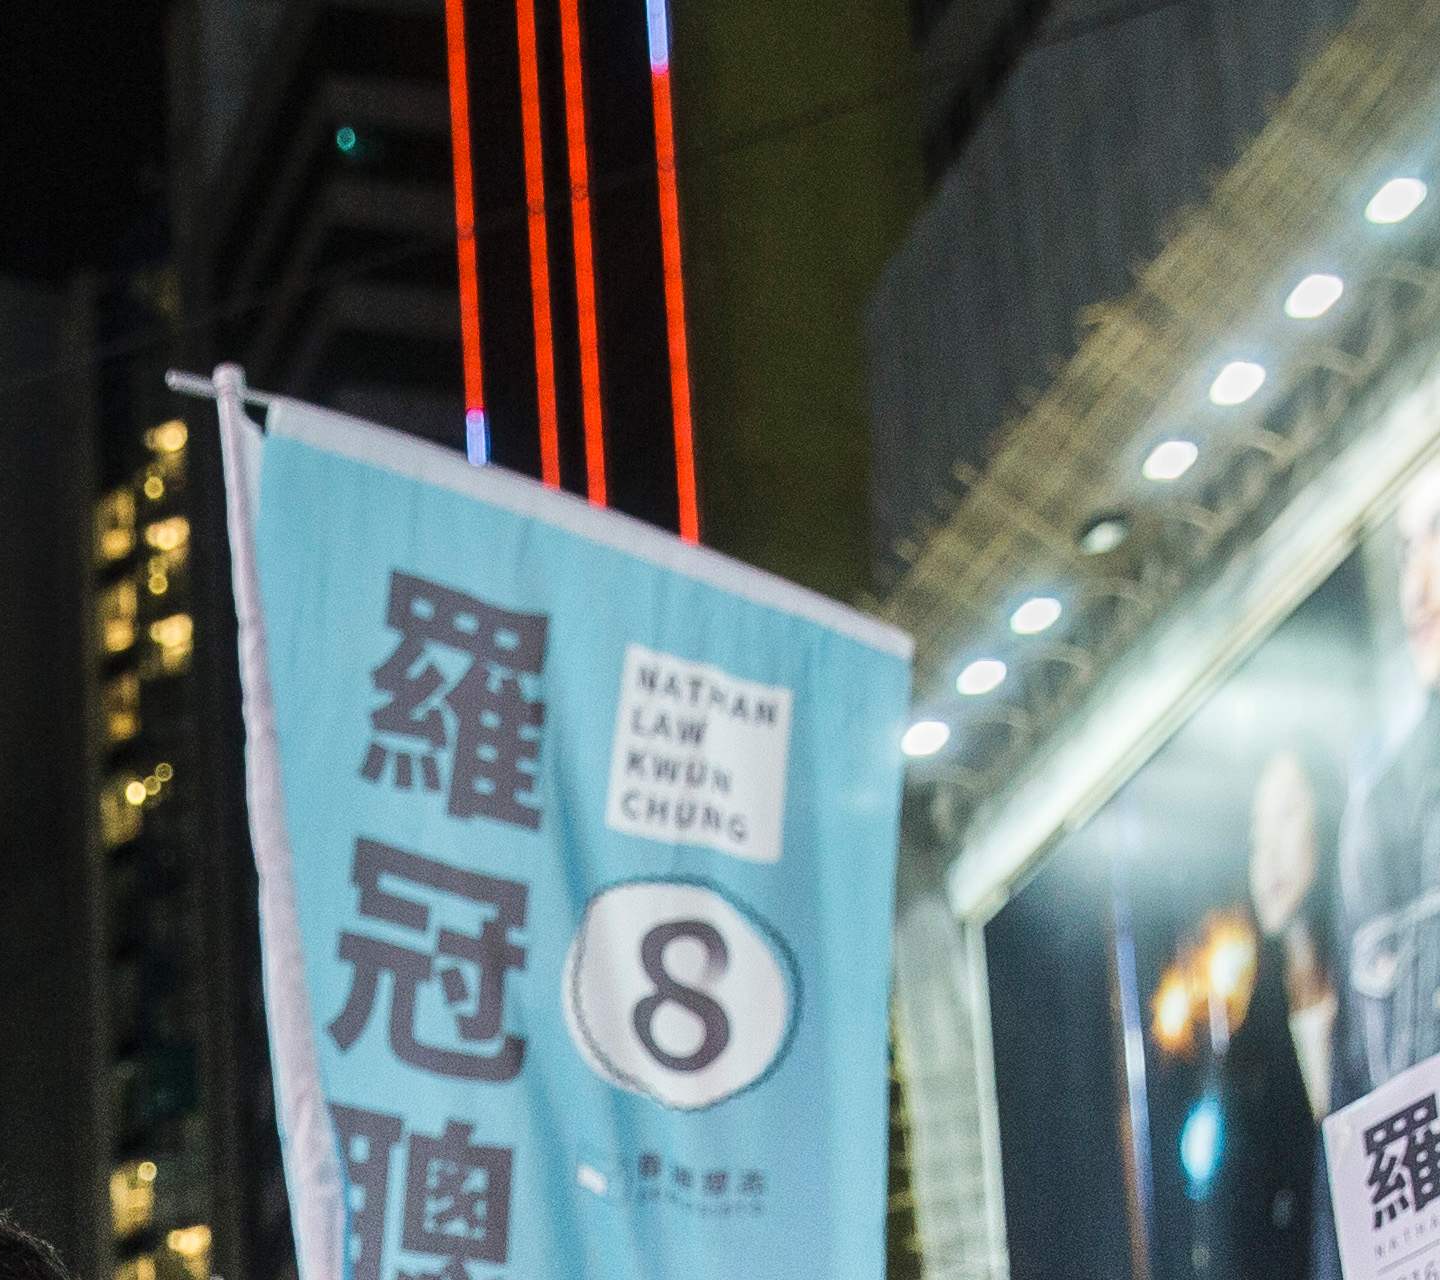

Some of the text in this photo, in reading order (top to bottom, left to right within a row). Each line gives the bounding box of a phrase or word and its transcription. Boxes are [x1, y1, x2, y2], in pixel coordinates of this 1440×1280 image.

[631, 705, 707, 746] LAW
[636, 665, 779, 728] NATHAN
[622, 789, 748, 844] CHUNG
[631, 917, 730, 1073] 8
